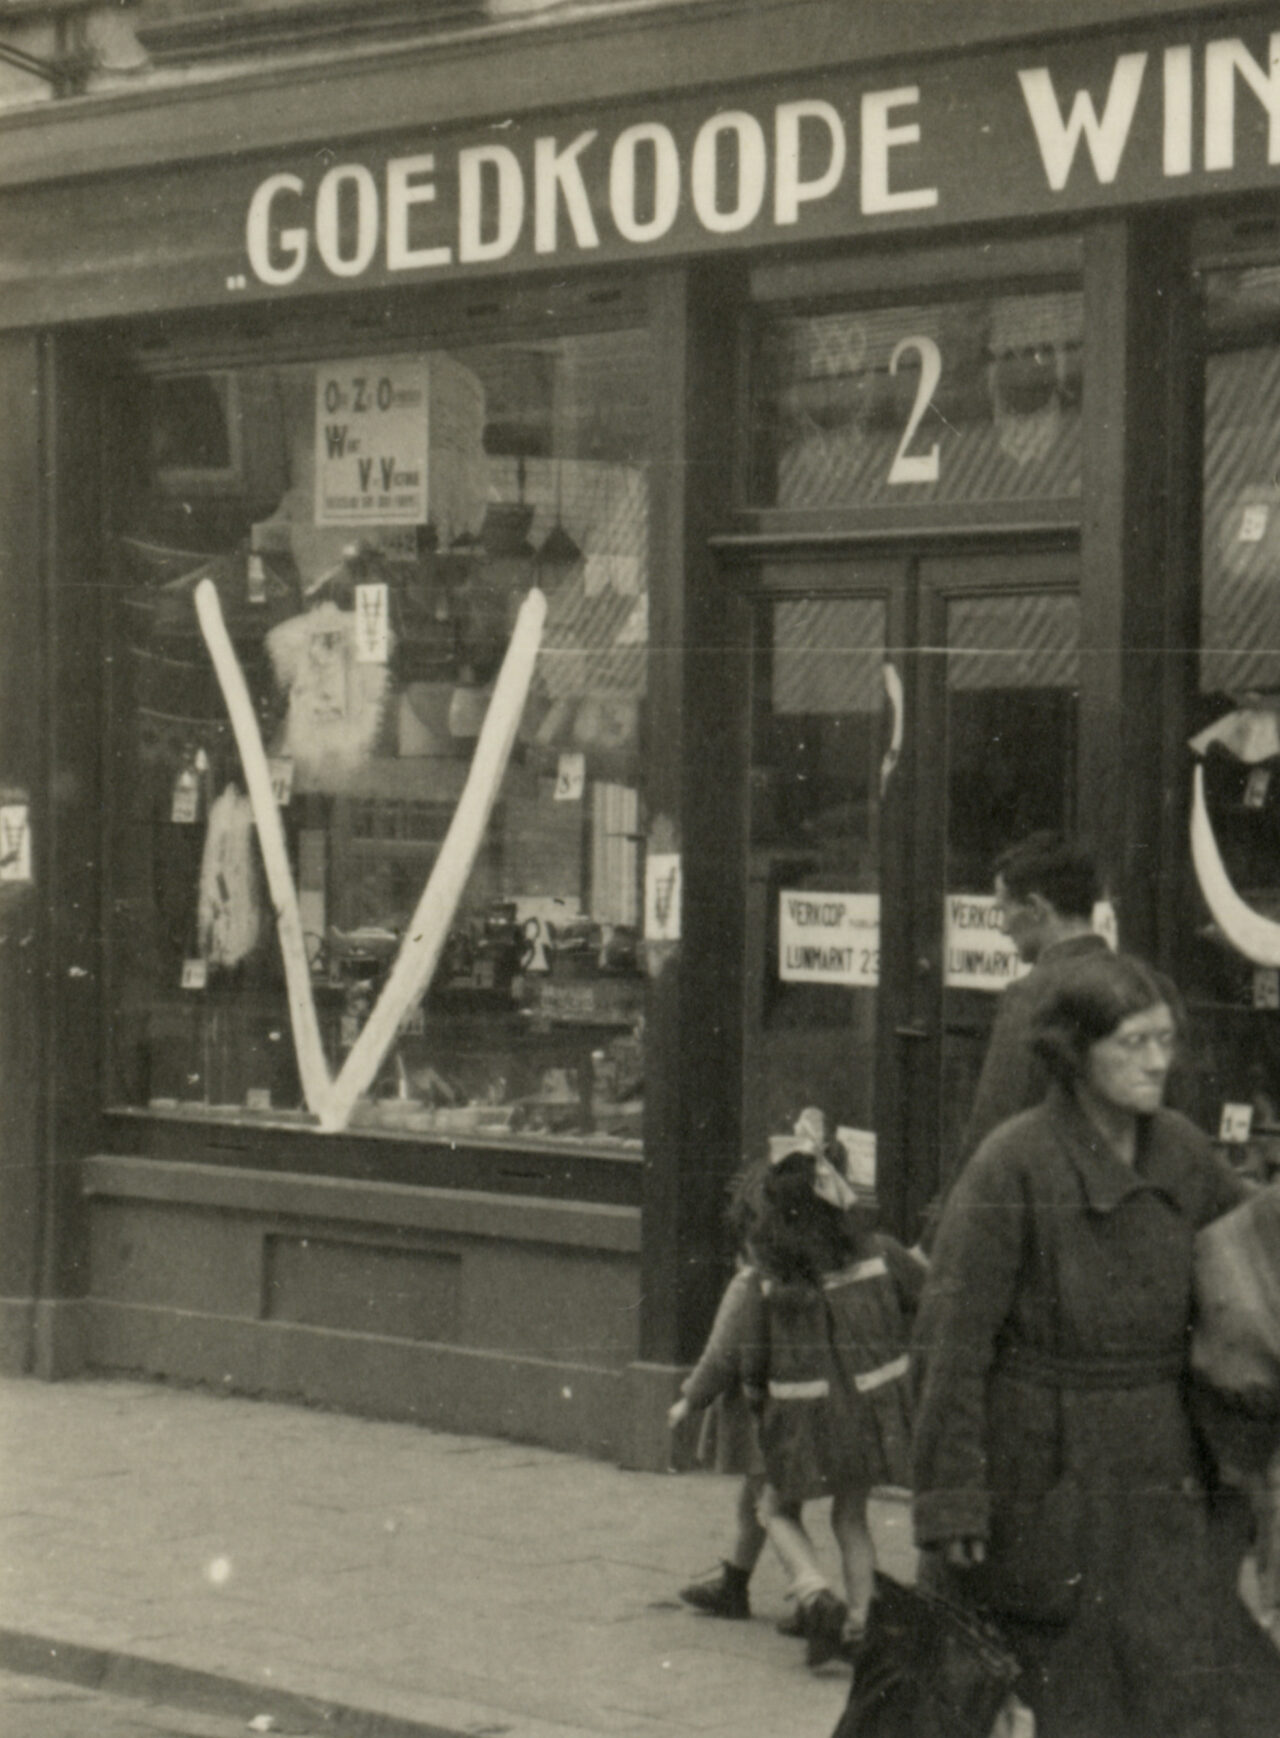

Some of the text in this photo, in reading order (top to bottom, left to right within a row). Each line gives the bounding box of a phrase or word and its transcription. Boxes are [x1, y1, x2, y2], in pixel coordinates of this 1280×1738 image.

[887, 335, 942, 485] 2
[194, 576, 547, 1135] V
[787, 898, 847, 928] VERKOOP
